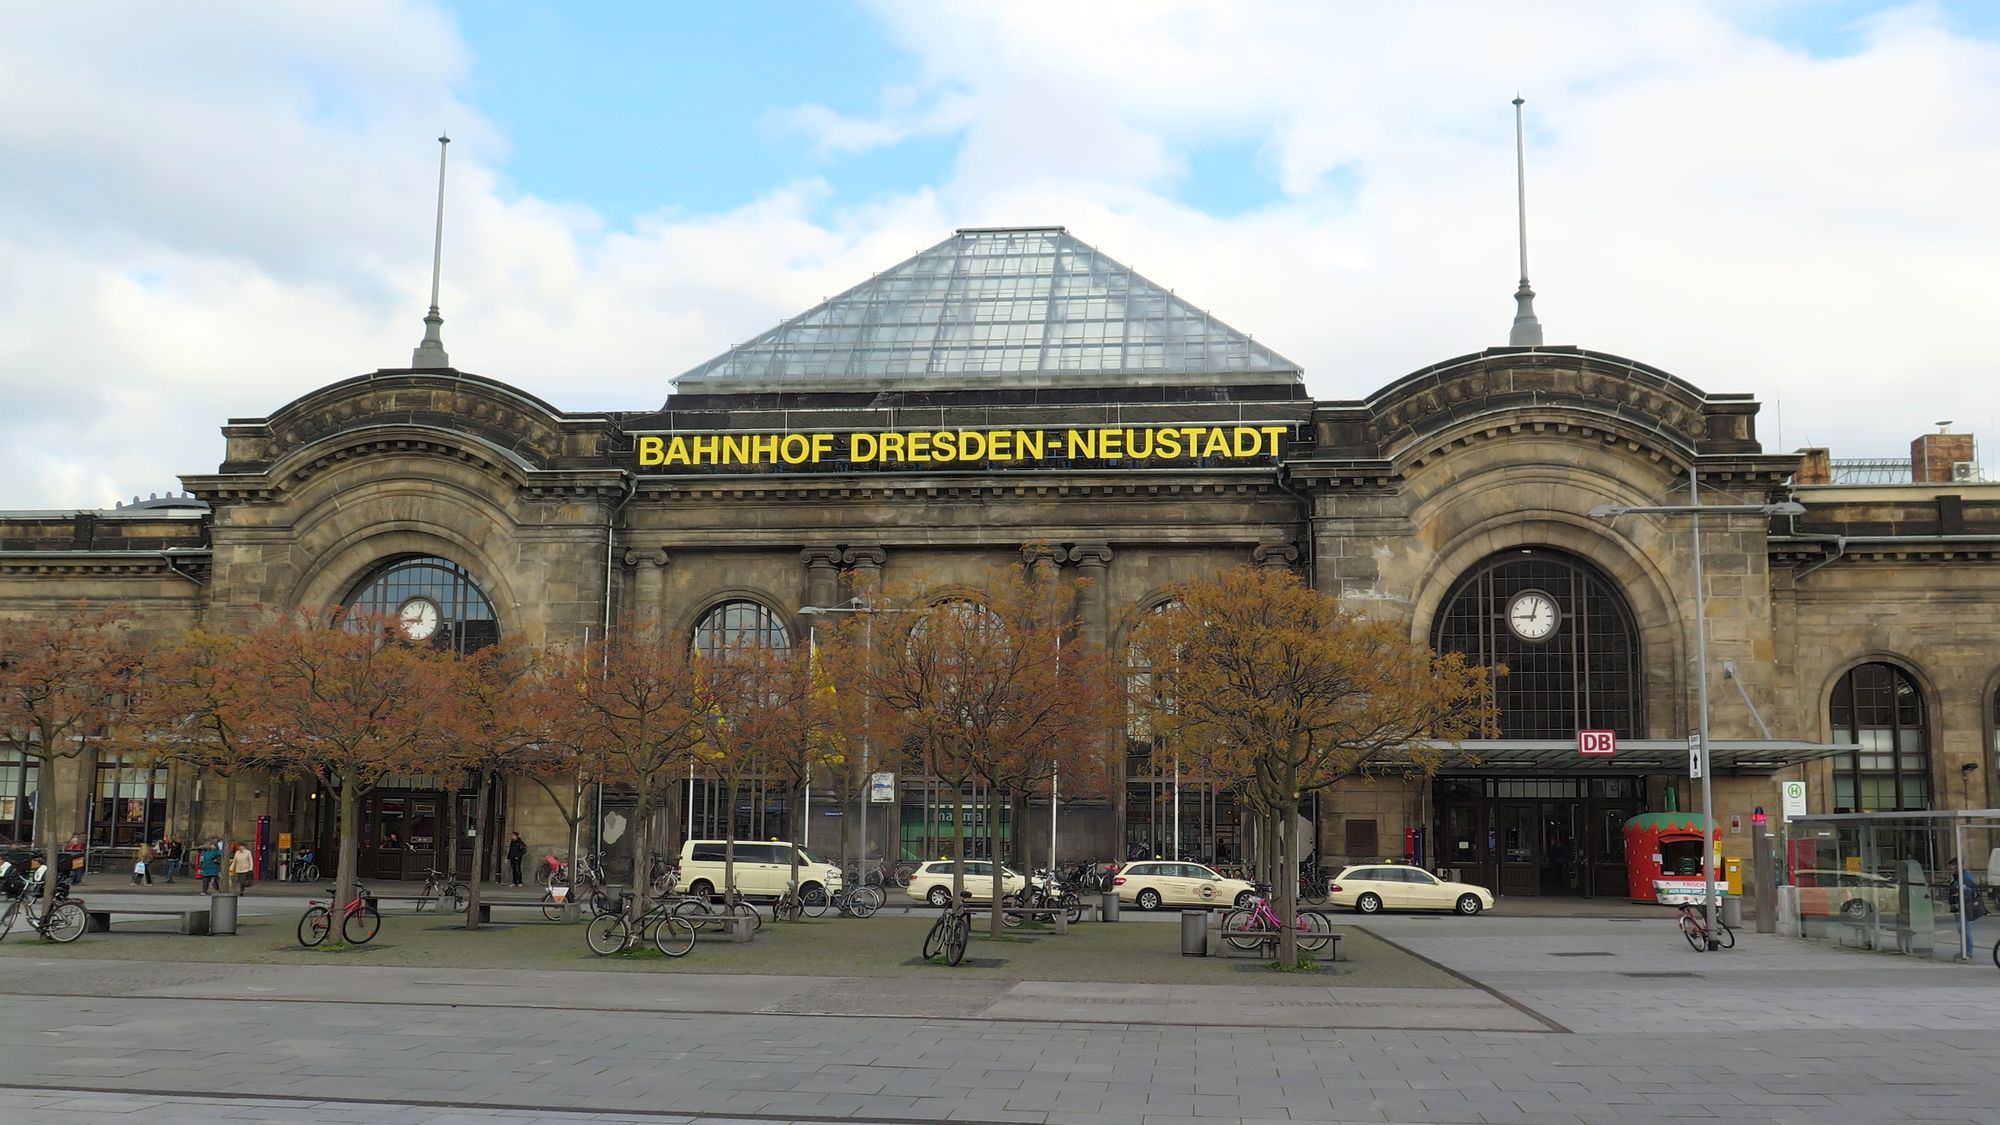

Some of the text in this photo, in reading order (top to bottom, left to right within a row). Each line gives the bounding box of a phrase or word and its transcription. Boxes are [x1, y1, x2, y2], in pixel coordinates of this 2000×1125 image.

[640, 427, 1287, 466] BAHNHOF DRESDEN-NEUSTADT
[1583, 734, 1611, 751] DB
[1791, 787, 1799, 795] H
